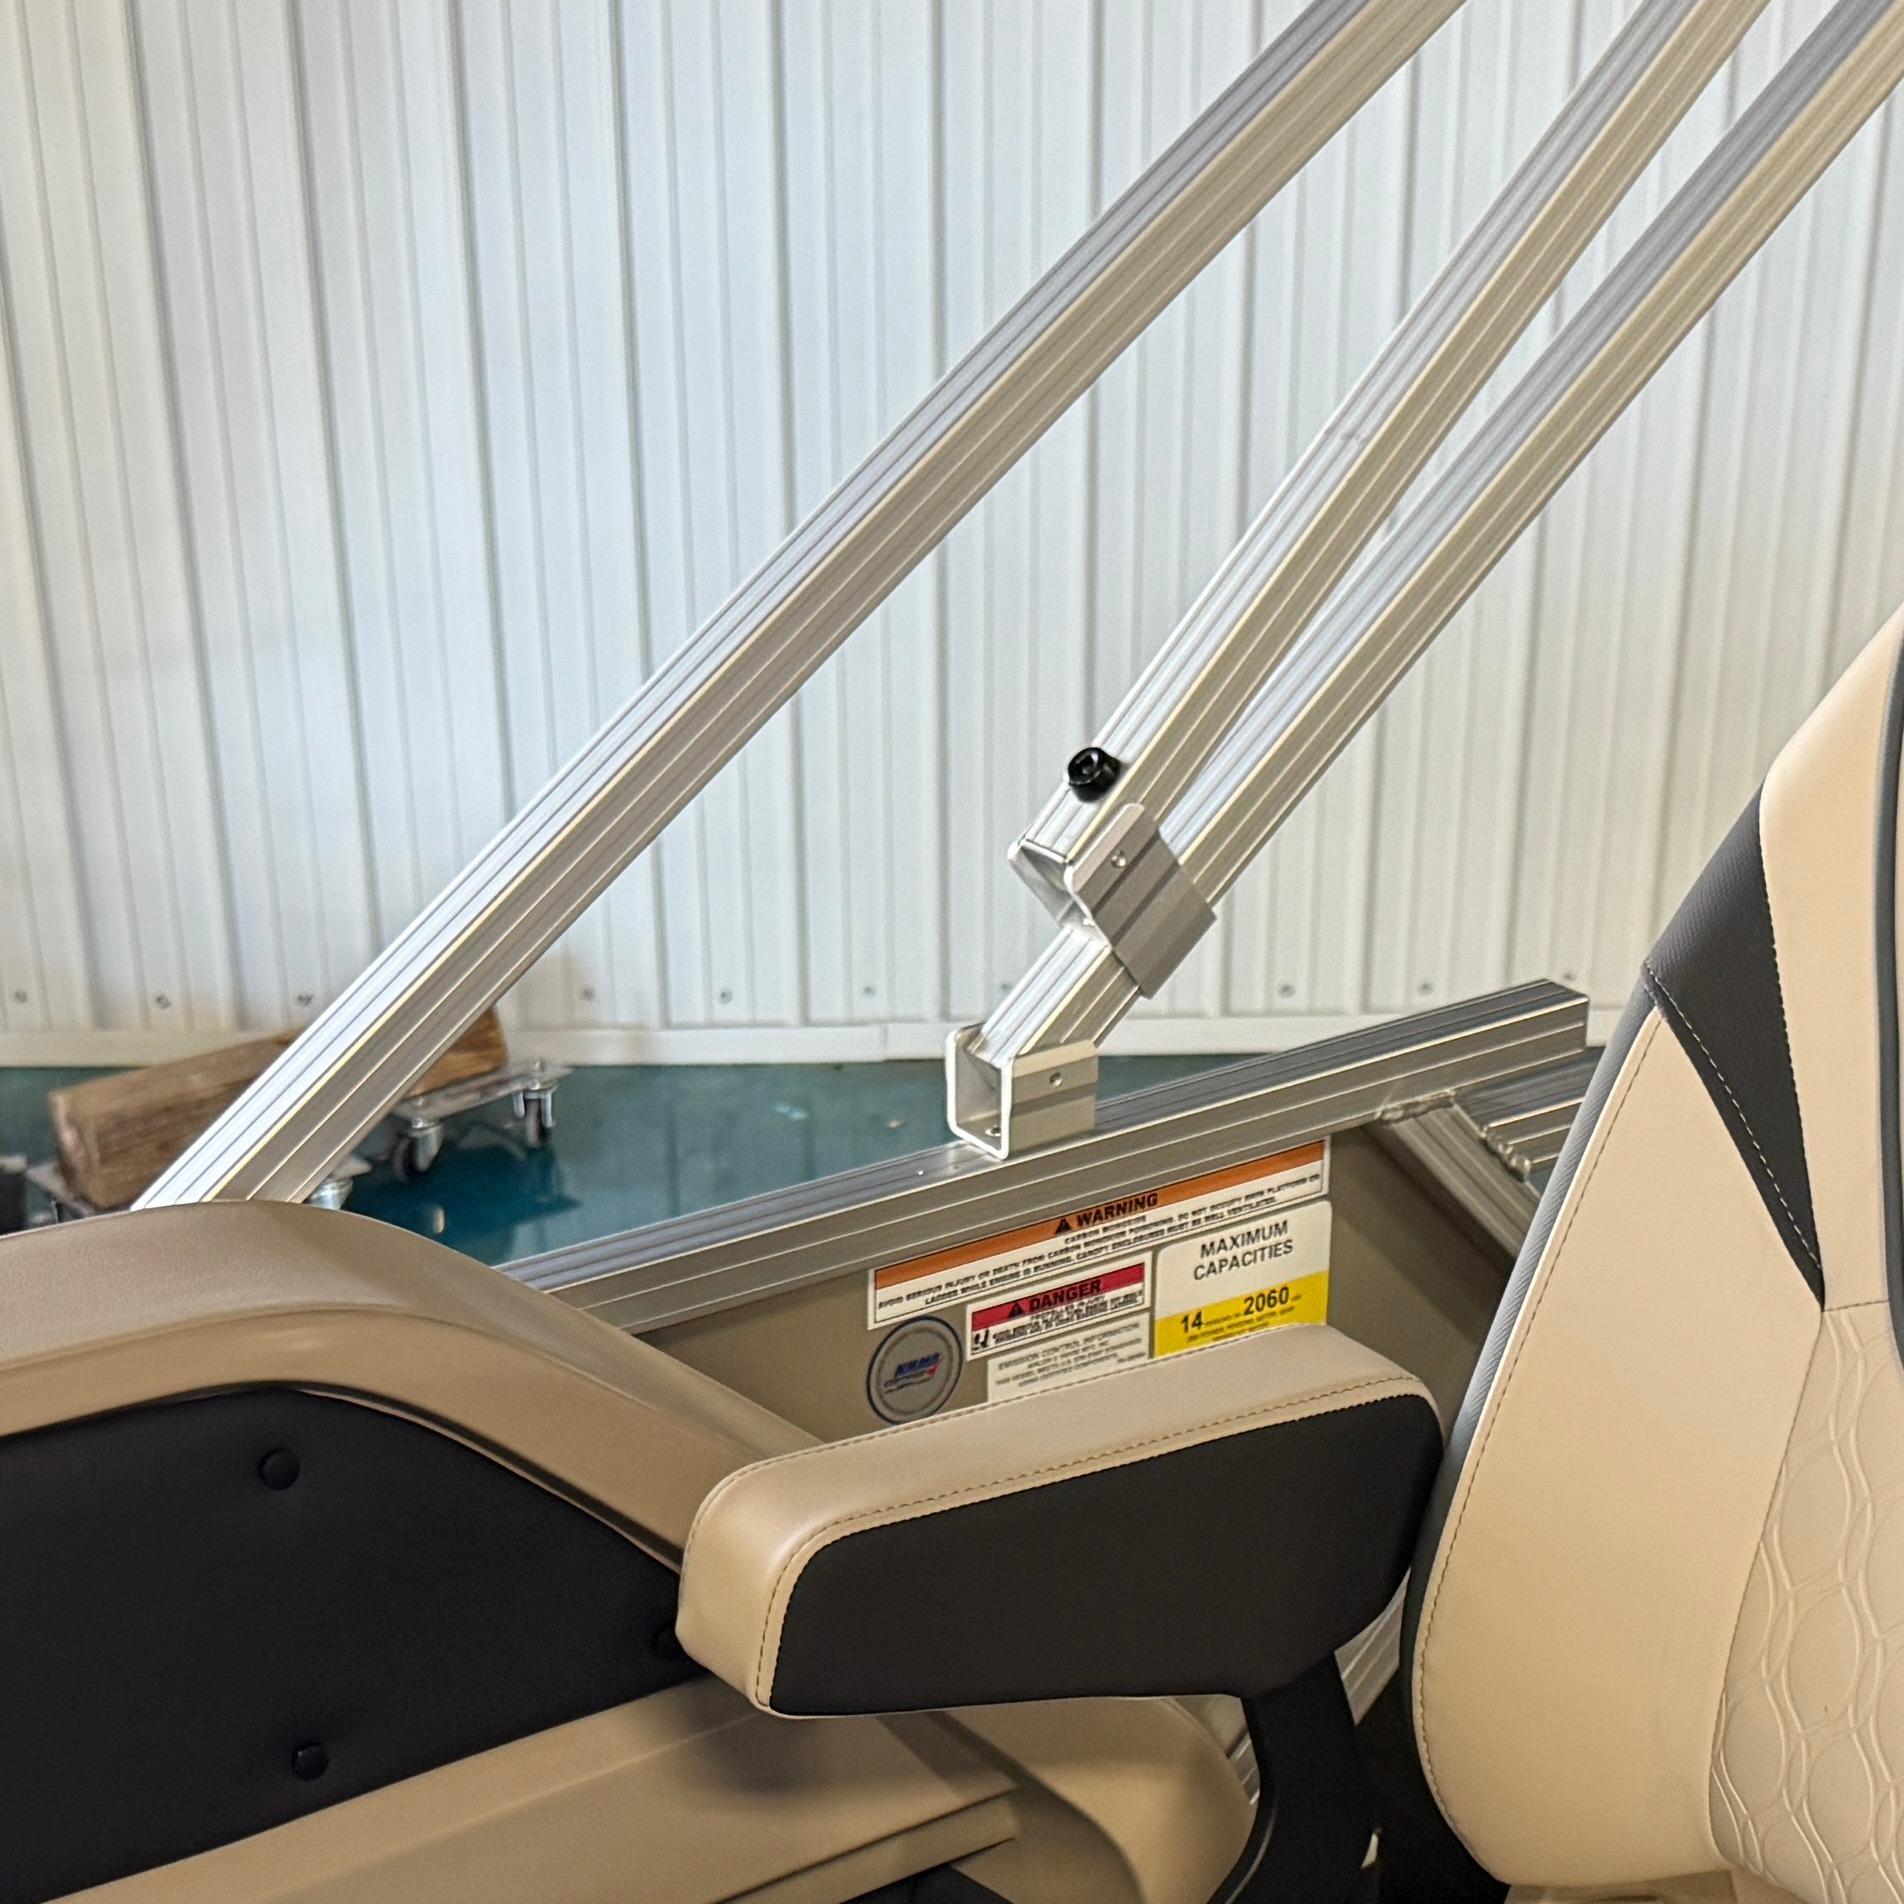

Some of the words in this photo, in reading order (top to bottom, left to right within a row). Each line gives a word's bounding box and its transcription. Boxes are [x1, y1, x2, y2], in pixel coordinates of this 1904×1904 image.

[1077, 1192, 1159, 1227] WARNING
[1200, 1220, 1288, 1259] MAXIMUM
[1193, 1239, 1294, 1280] CAPACITIES
[1029, 1279, 1103, 1312] DANGER
[1181, 1310, 1204, 1333] 14
[1244, 1286, 1290, 1316] 2060
